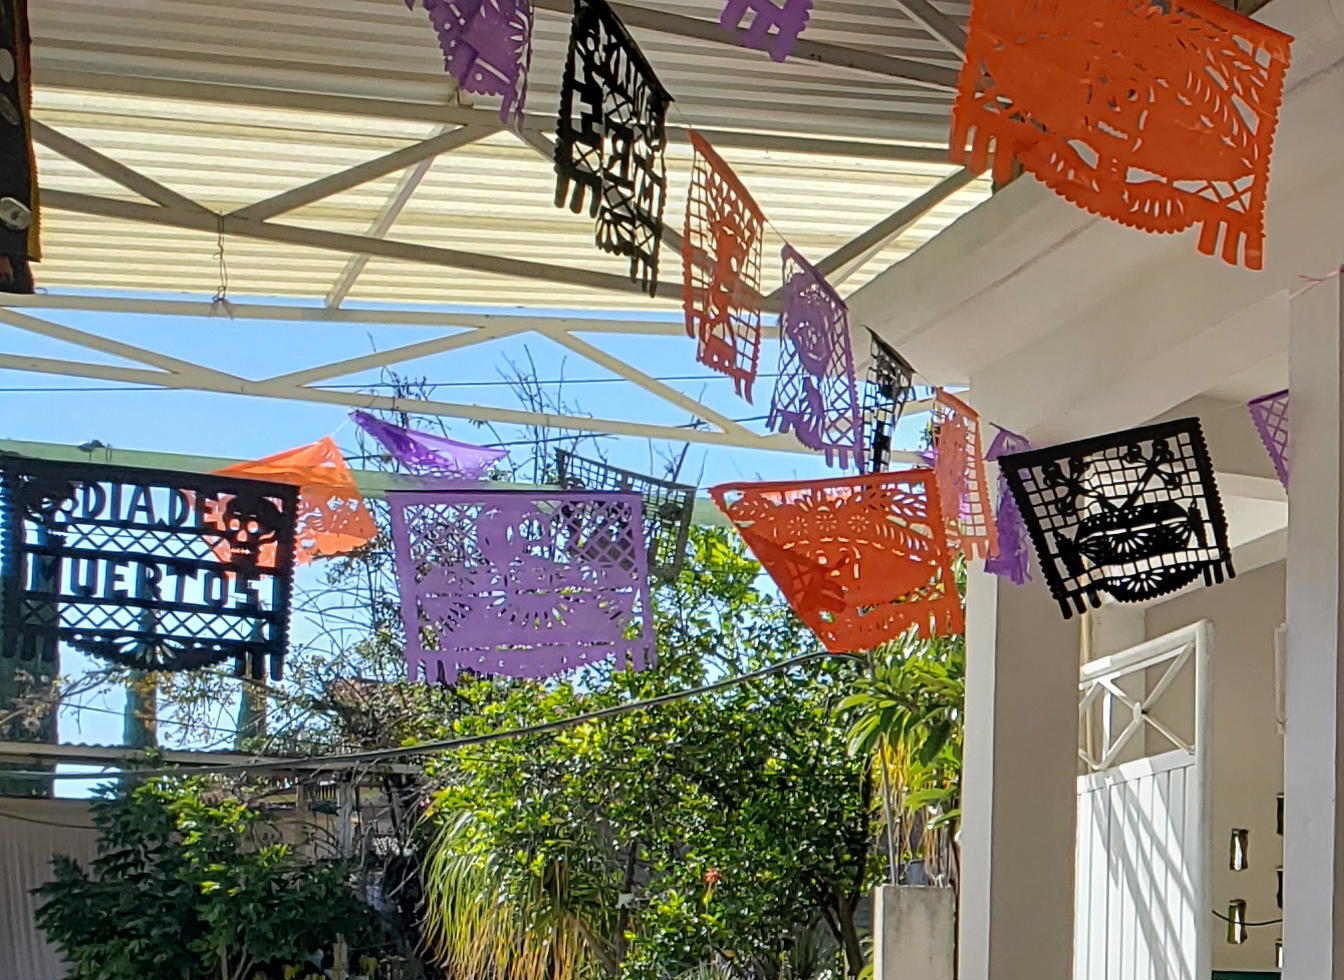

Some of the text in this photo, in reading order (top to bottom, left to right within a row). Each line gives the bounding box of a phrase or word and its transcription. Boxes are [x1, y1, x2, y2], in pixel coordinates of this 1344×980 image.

[81, 480, 229, 533] DIA DE
[28, 550, 264, 614] MUERTOS
